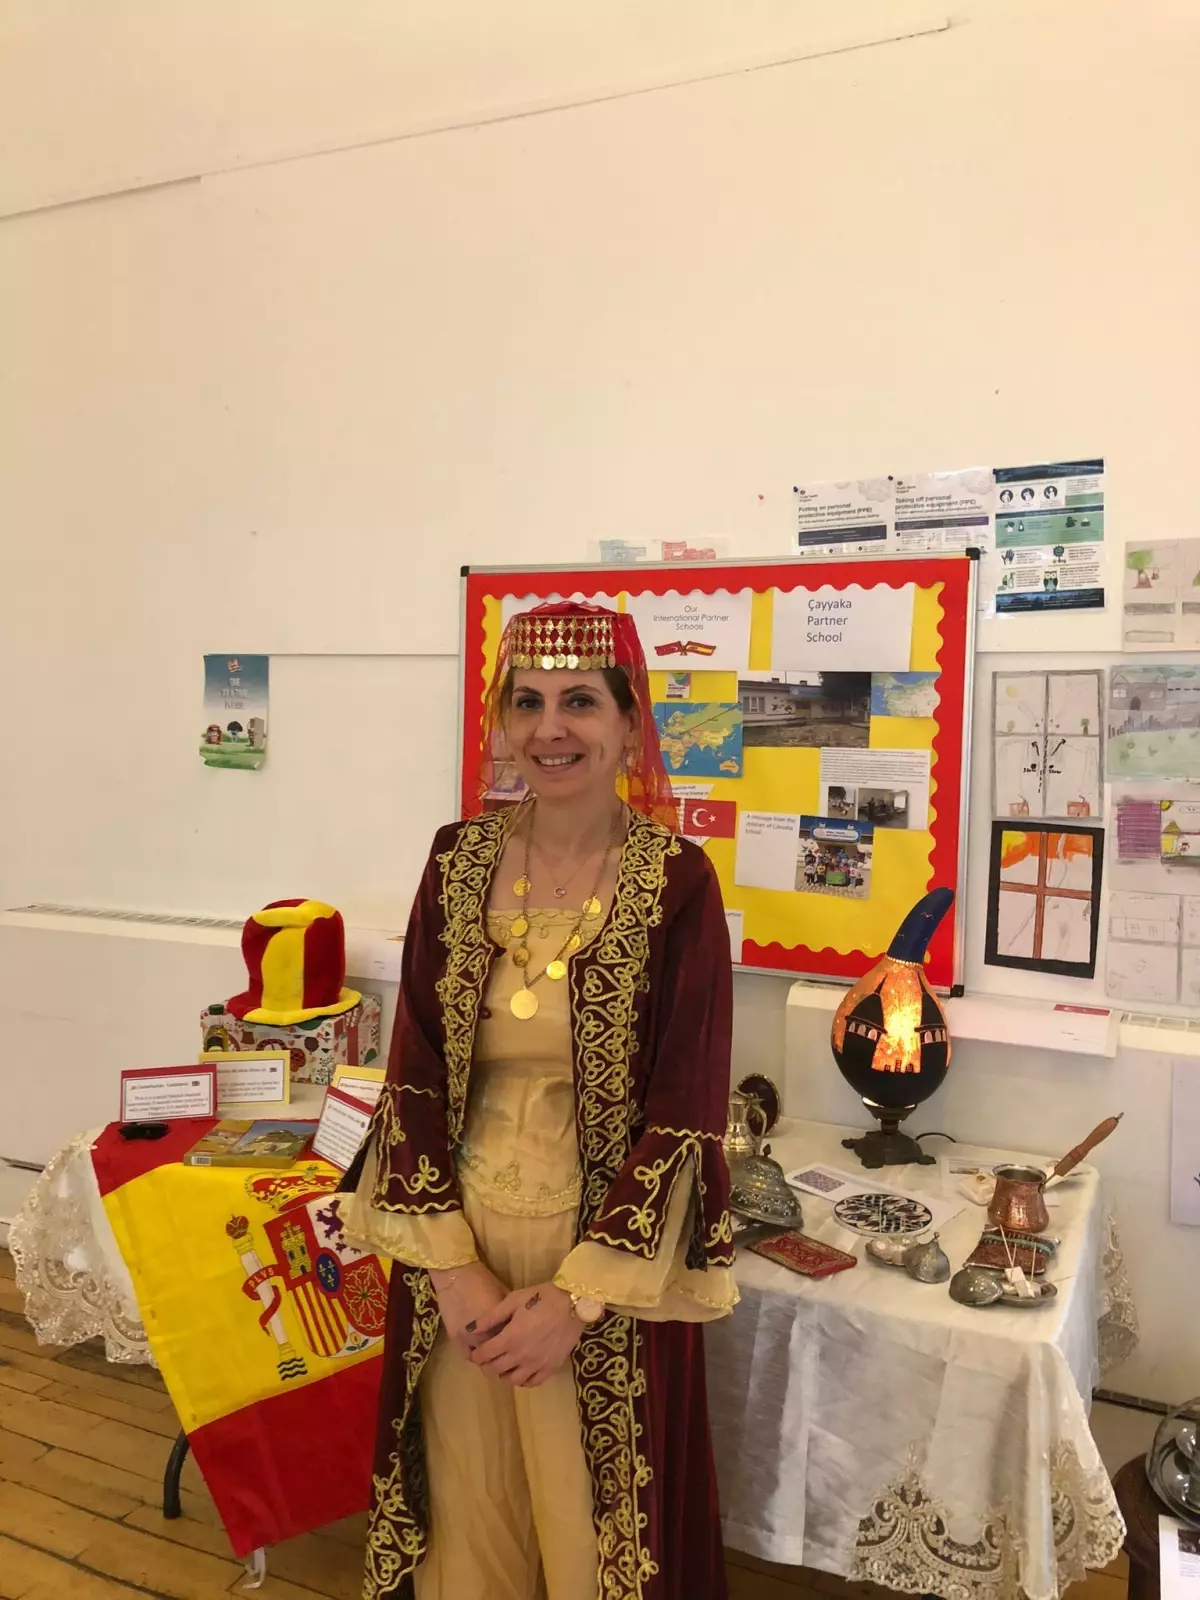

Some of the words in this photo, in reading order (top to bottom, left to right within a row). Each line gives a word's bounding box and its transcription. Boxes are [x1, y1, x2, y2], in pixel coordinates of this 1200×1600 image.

[925, 494, 952, 502] personal
[895, 502, 925, 510] protective
[683, 605, 698, 613] Our
[808, 598, 852, 611] Çayyaka
[653, 614, 700, 622] International
[701, 613, 730, 622] Partner
[807, 615, 848, 626] Partner
[675, 622, 704, 631] Schools
[806, 631, 843, 643] School
[248, 1267, 274, 1288] PLVS
